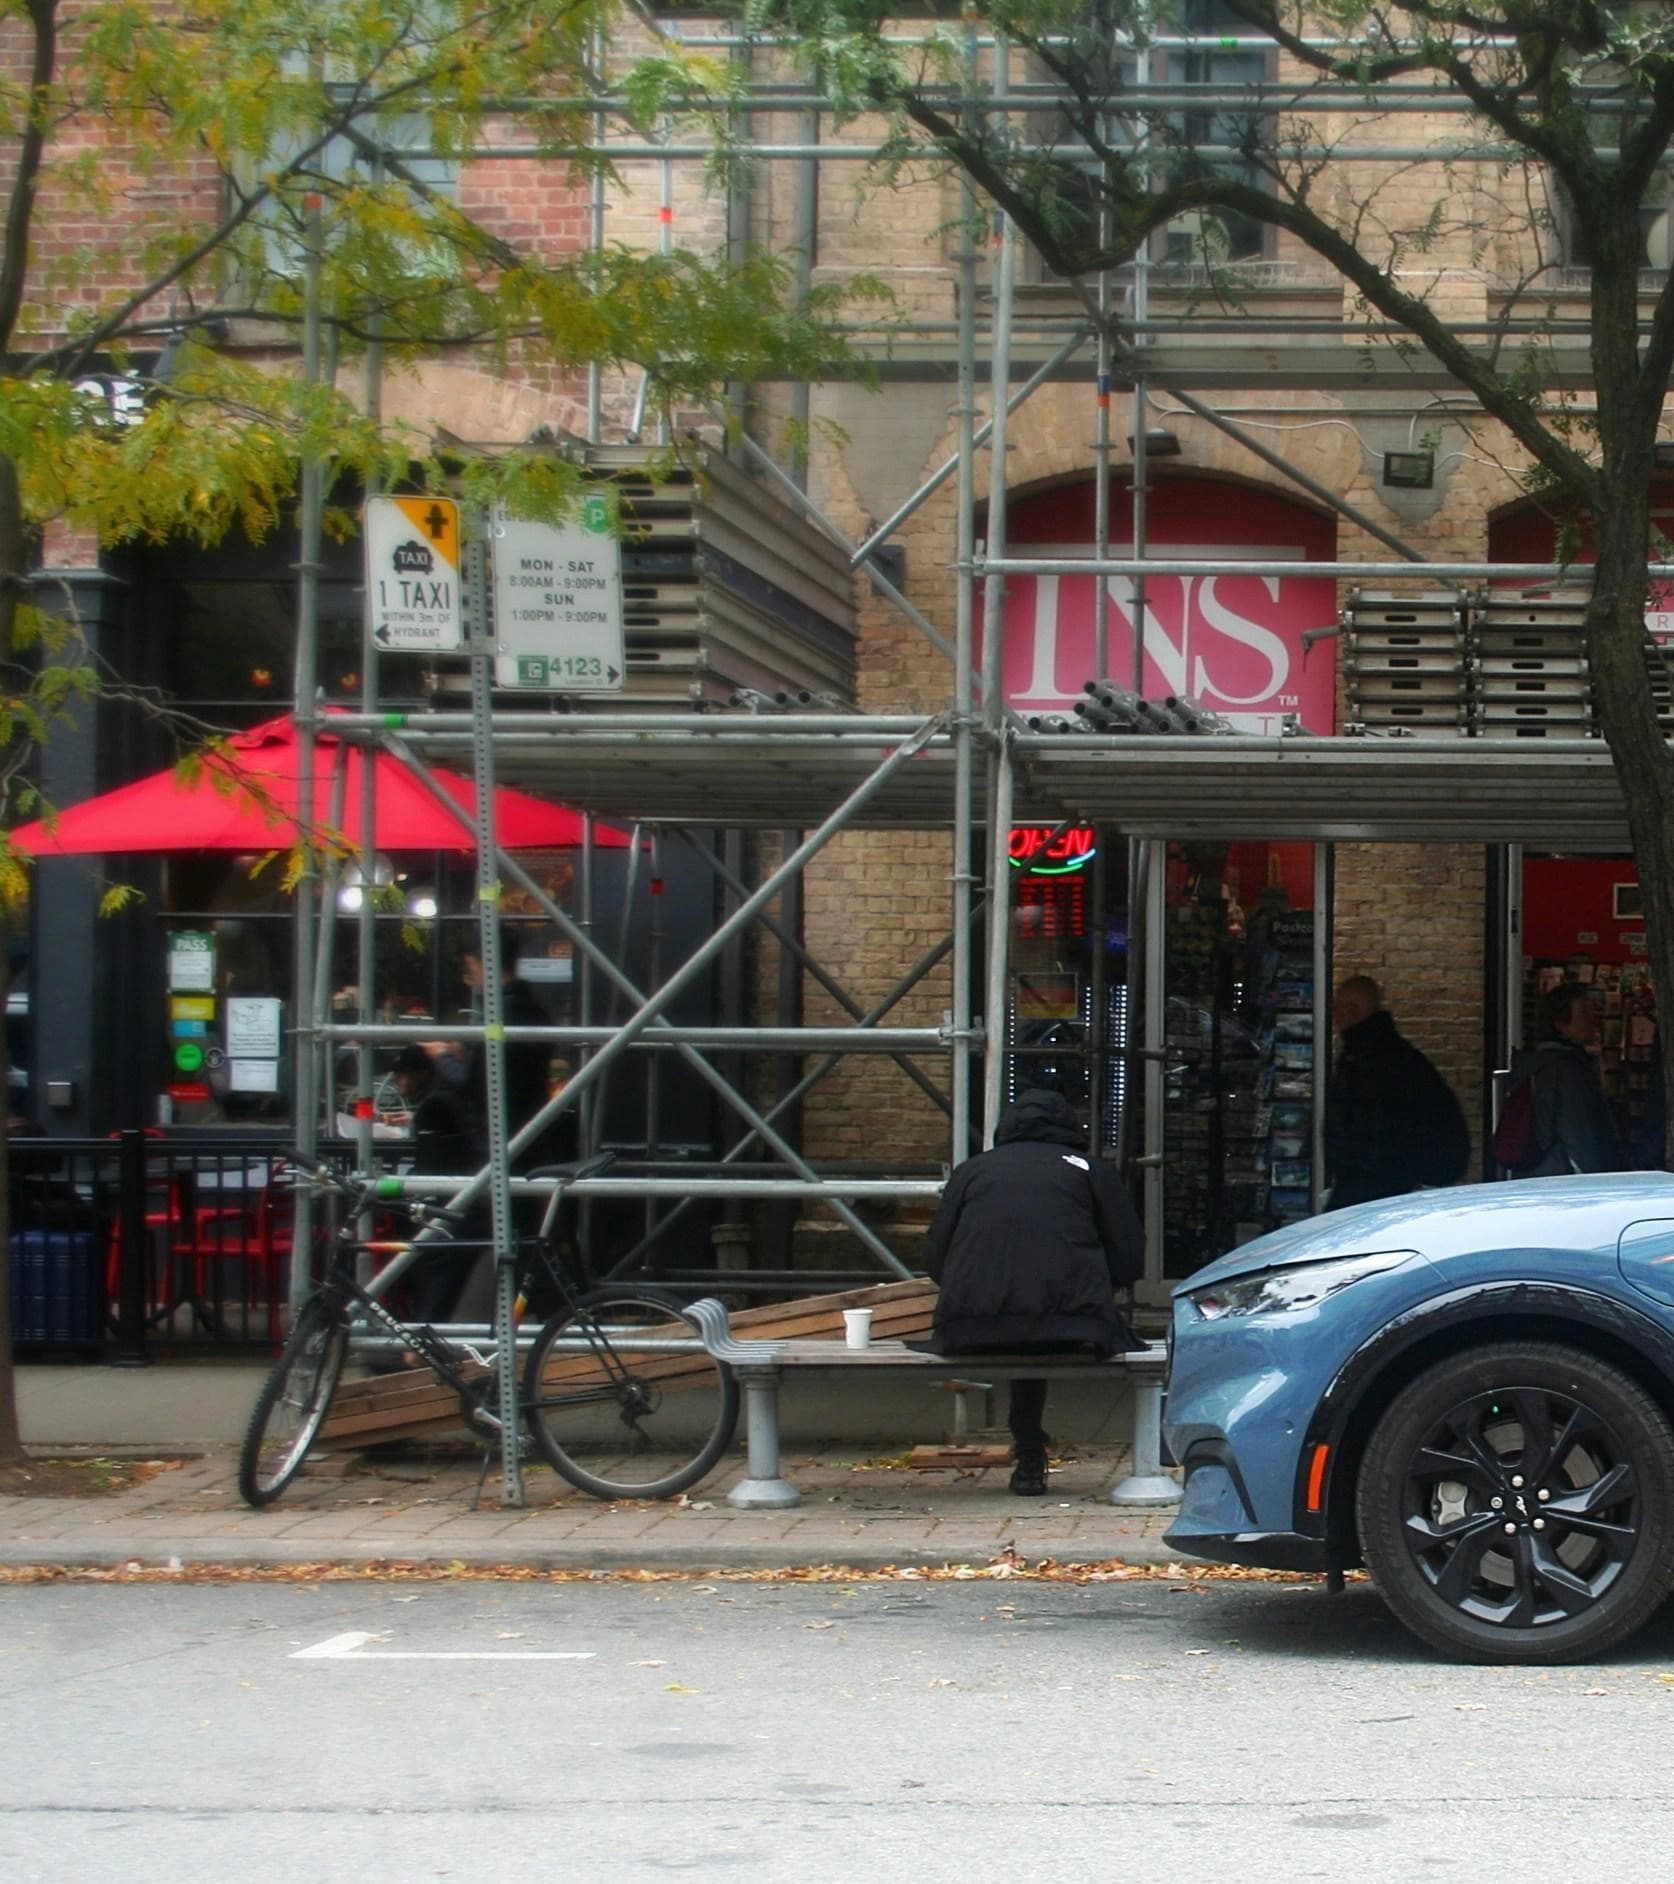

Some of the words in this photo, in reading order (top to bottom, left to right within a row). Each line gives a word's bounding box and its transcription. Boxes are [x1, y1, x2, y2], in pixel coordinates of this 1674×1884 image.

[400, 551, 428, 565] TAXI
[521, 560, 553, 571] MON
[568, 561, 594, 573] SAT
[510, 576, 553, 588] 8:00AM
[565, 578, 606, 590] 9:00PM
[380, 581, 387, 608] 1
[400, 582, 450, 609] TAXI
[544, 594, 575, 606] SUN
[382, 612, 415, 622] WITHIN
[438, 614, 450, 624] OF
[512, 610, 554, 621] 1:00PM
[565, 611, 607, 623] 9:00PM
[394, 628, 441, 638] HYDRANT
[550, 658, 602, 676] 4123
[1278, 696, 1298, 706] TM
[176, 939, 208, 951] PASS
